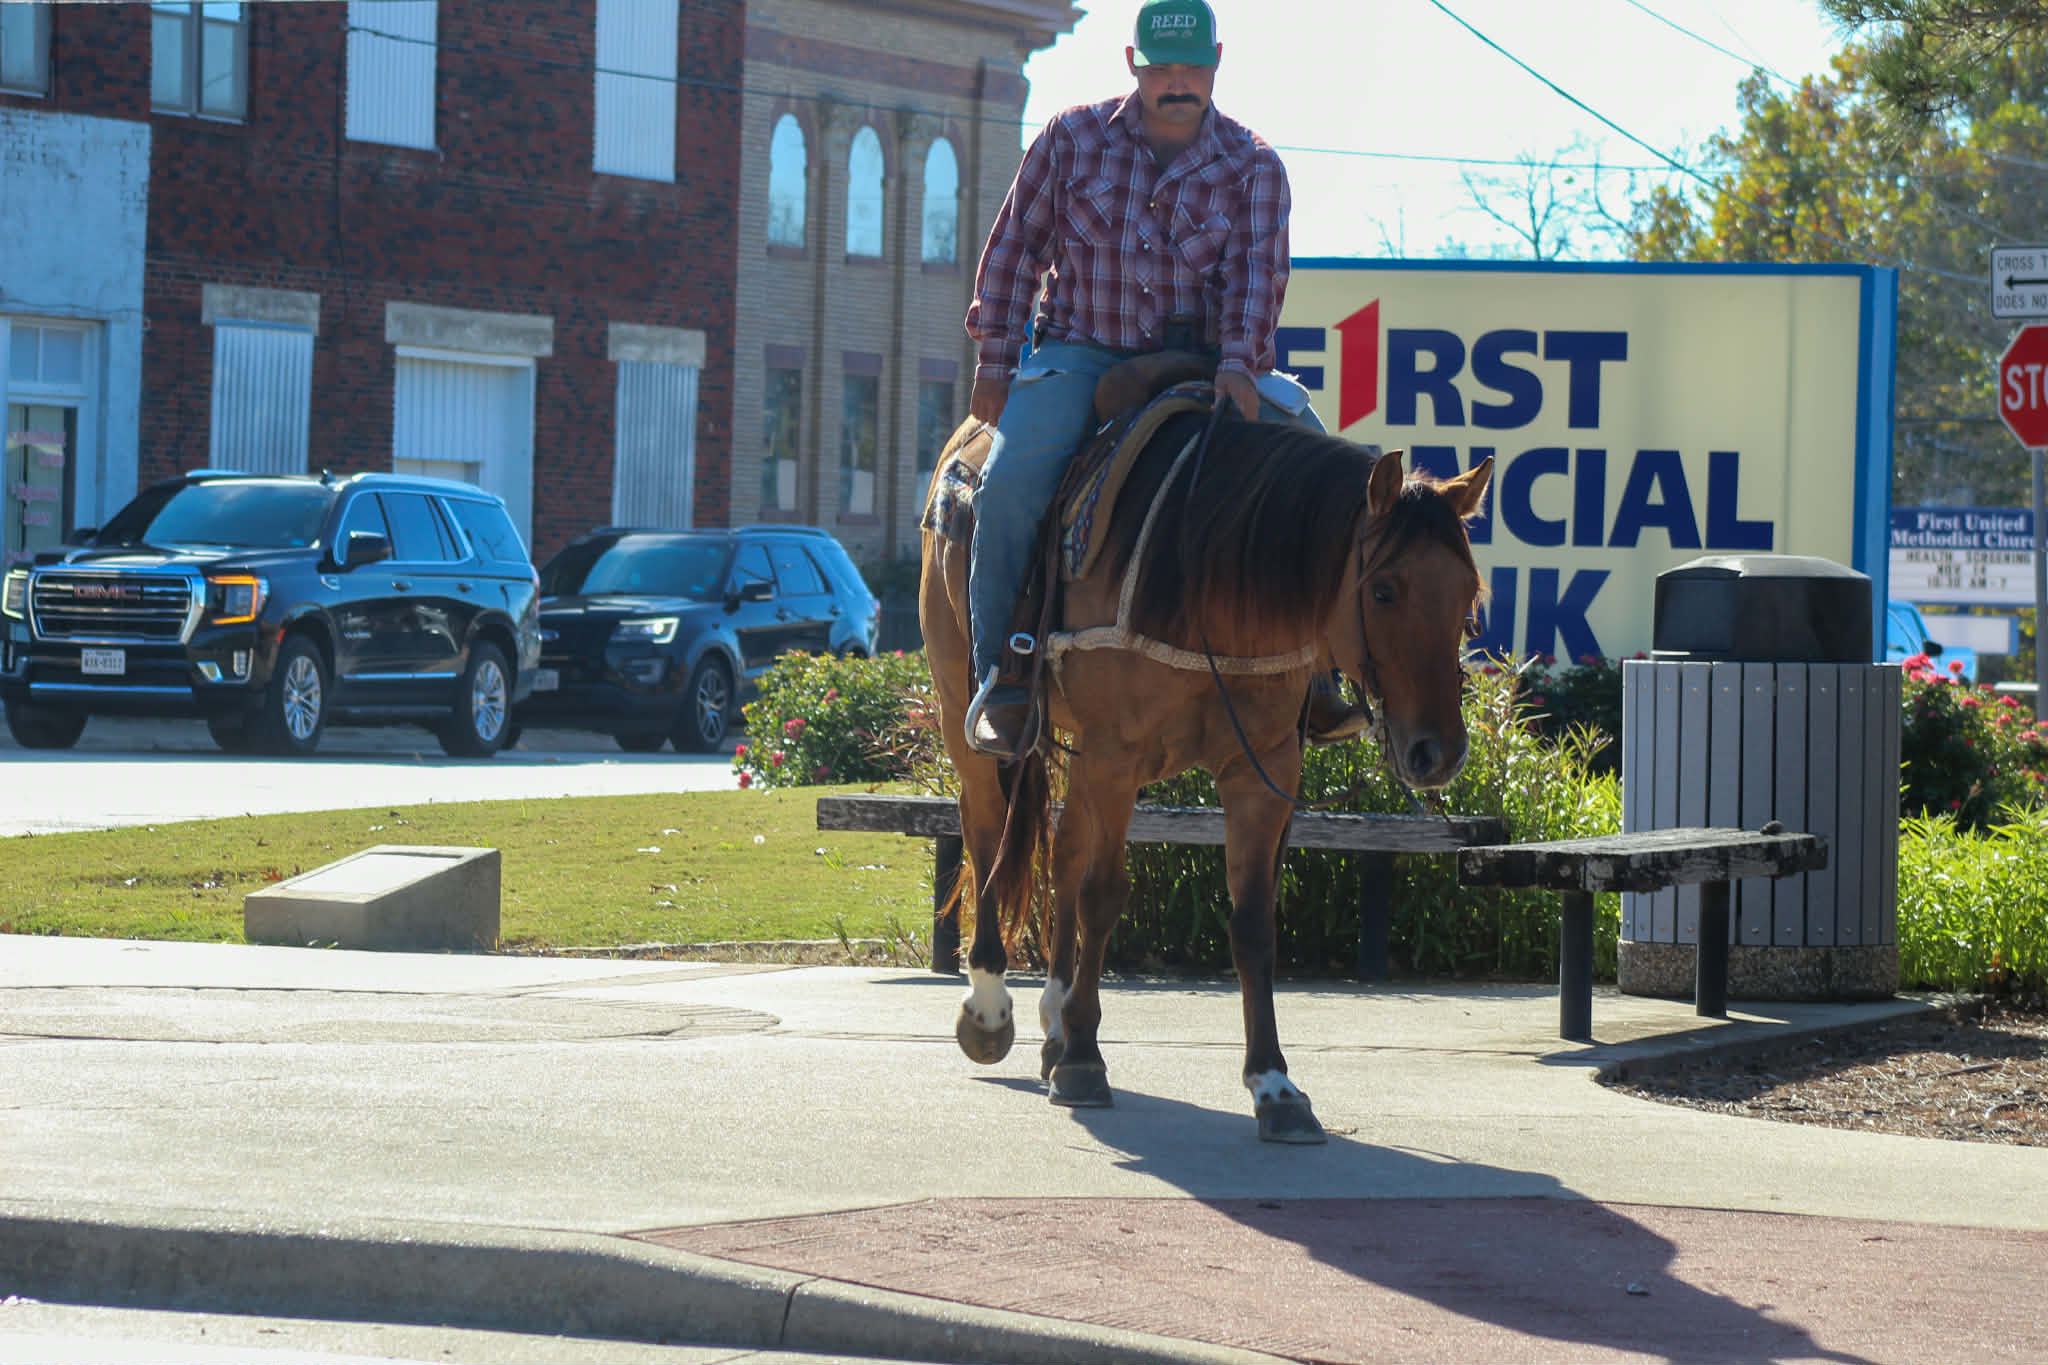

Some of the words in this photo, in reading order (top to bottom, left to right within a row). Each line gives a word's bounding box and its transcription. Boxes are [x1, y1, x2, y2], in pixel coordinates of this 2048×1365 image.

[1151, 14, 1197, 29] REED
[1997, 254, 2034, 271] CROSS
[1996, 294, 2025, 310] DOES
[2031, 294, 2048, 310] NO
[2005, 364, 2048, 410] ST
[1917, 512, 1960, 530] First
[1965, 513, 2026, 531] United
[1891, 530, 1980, 547] Methodist
[1983, 531, 2037, 548] Churc
[1906, 551, 1953, 563] HEALTH
[73, 584, 141, 600] GMC
